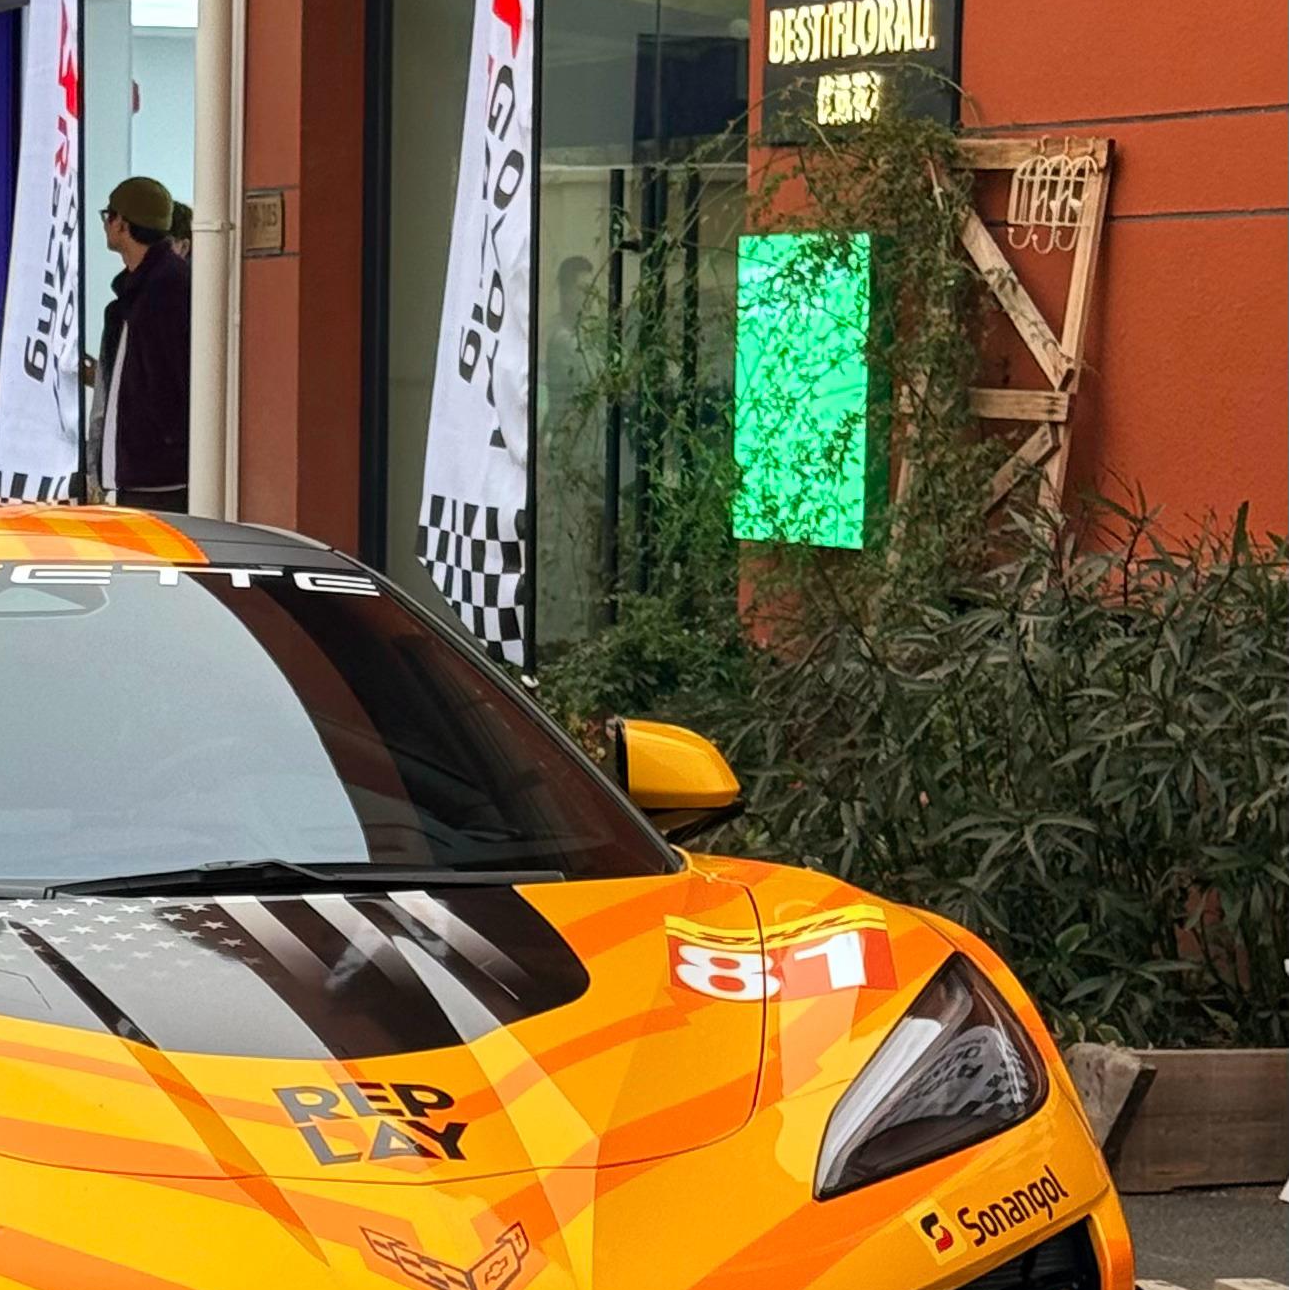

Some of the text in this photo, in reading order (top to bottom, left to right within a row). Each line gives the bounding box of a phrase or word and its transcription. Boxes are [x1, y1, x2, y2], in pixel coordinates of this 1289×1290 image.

[675, 930, 868, 1002] 81
[272, 1081, 455, 1124] REP
[297, 1119, 469, 1166] LAY
[957, 1164, 1070, 1247] Sonangol
